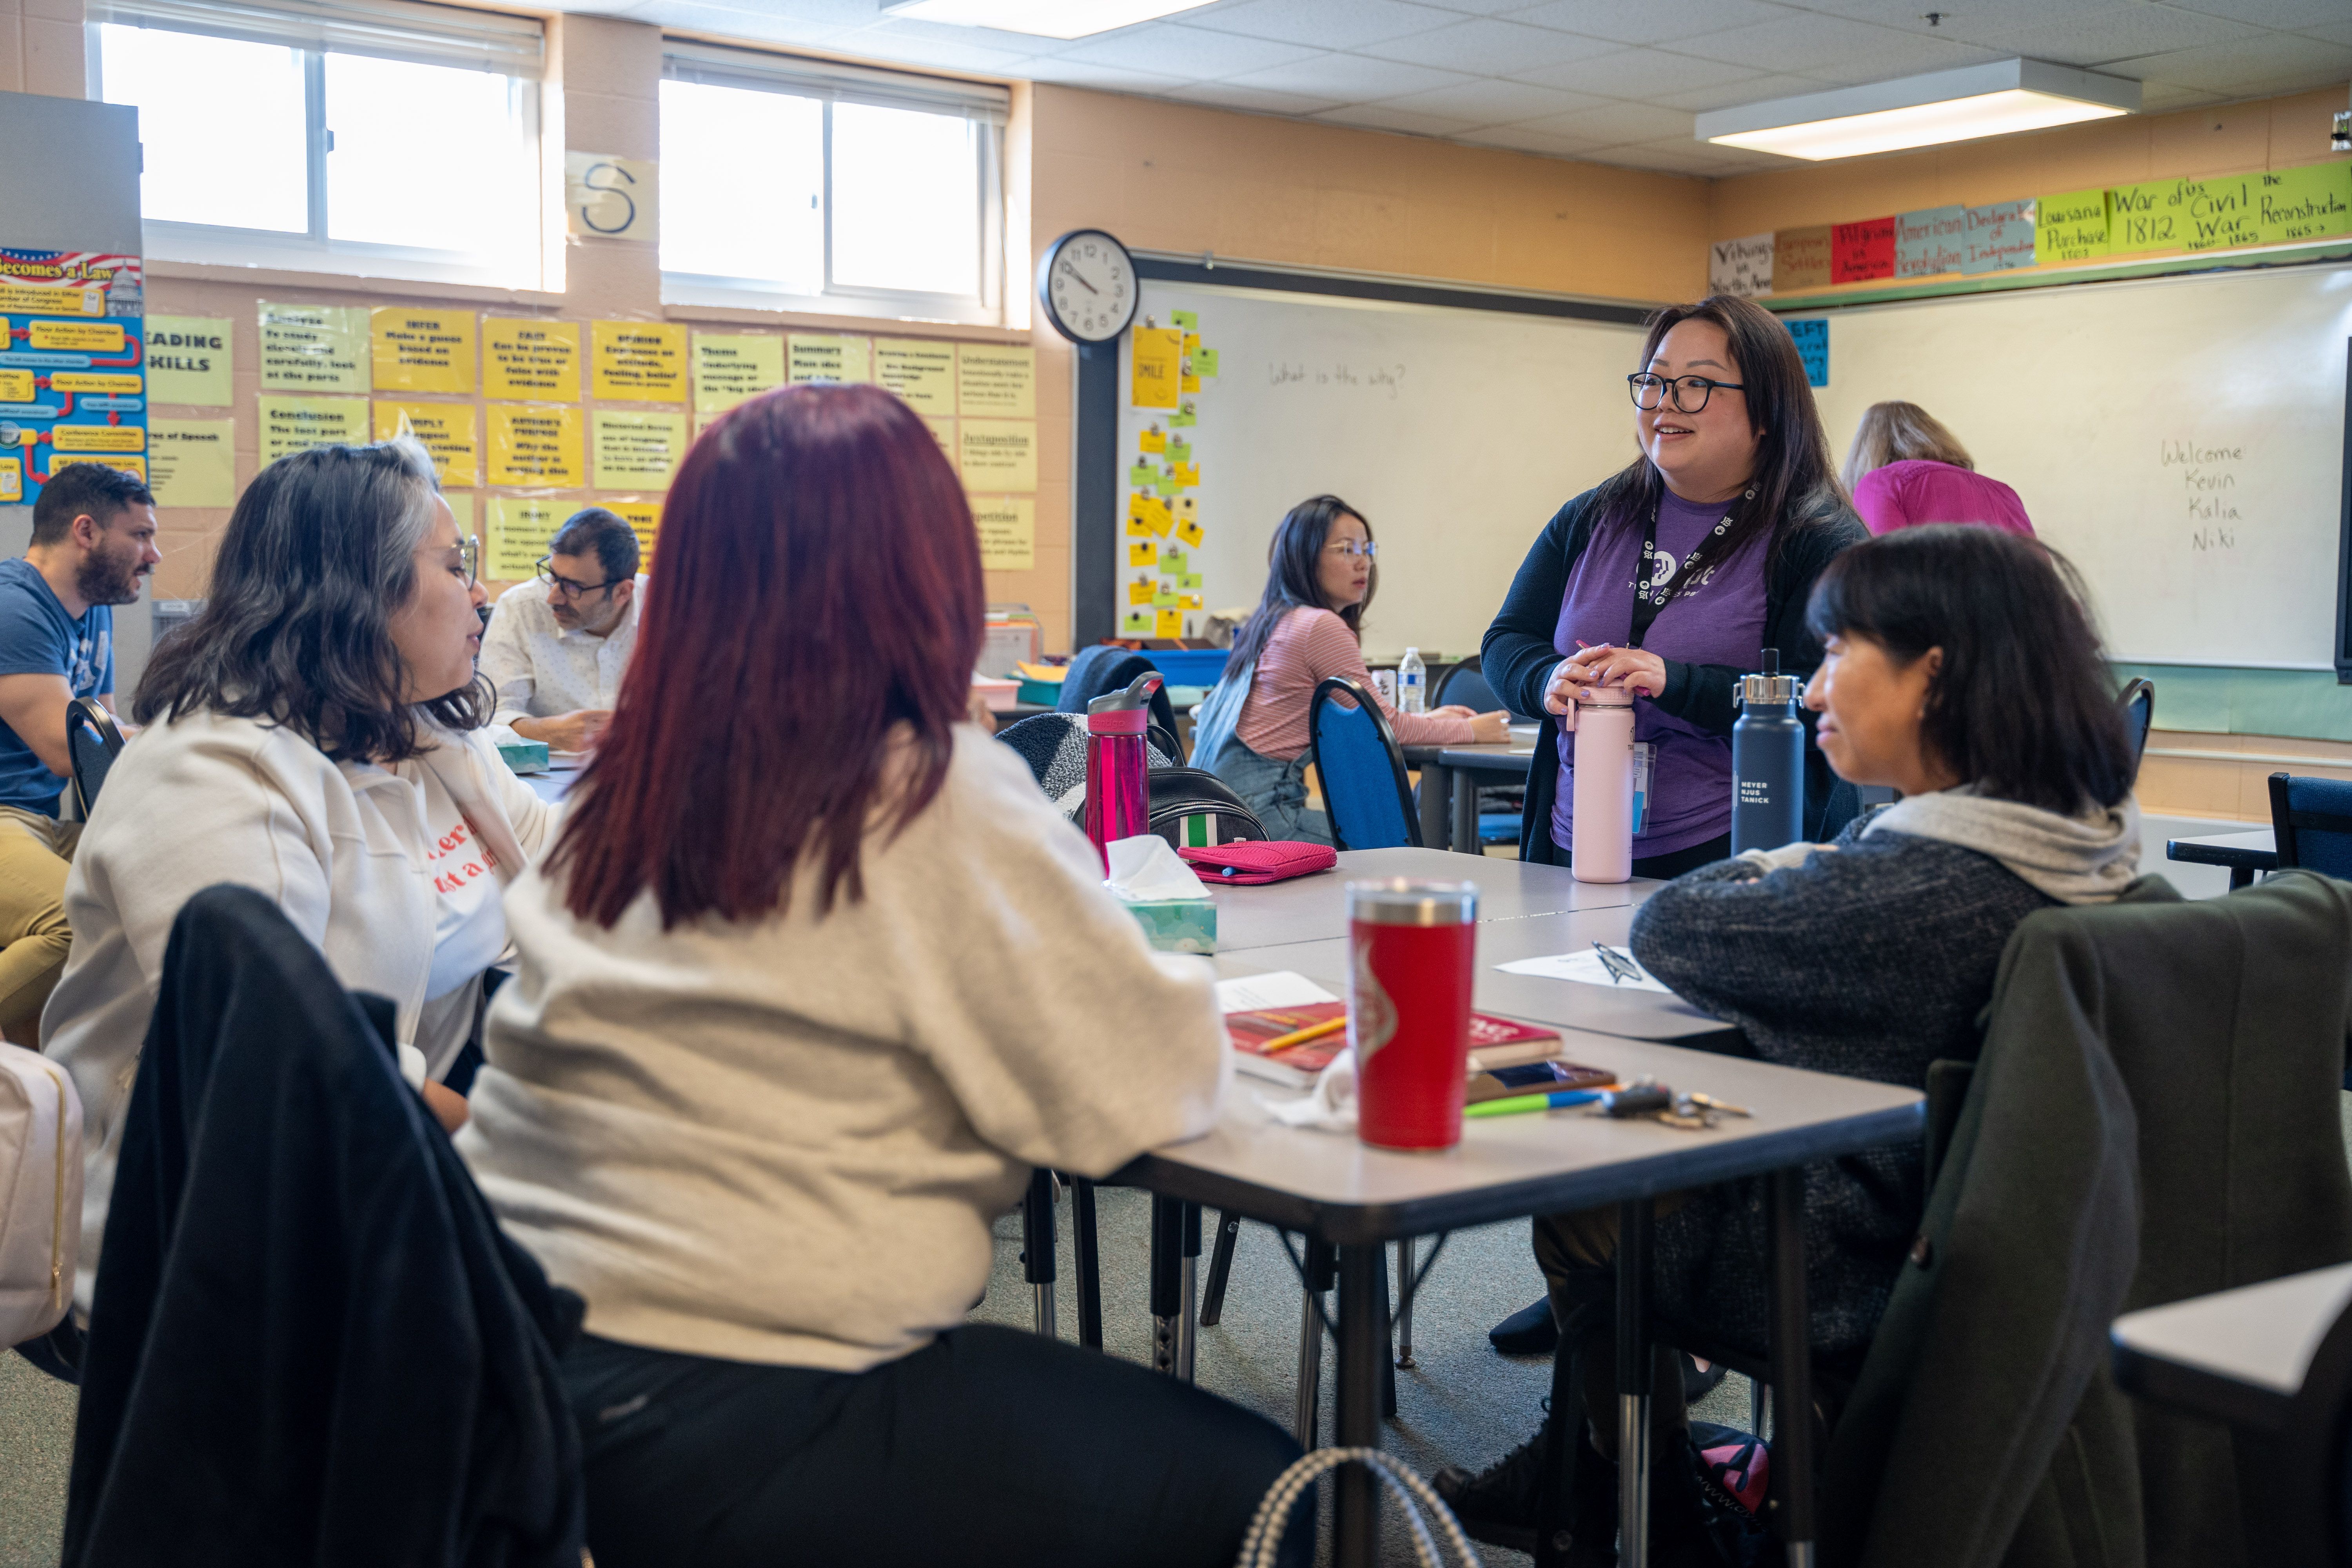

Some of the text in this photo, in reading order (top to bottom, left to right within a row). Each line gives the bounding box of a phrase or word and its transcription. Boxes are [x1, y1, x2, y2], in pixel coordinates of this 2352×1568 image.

[581, 161, 636, 234] S
[2114, 180, 2184, 213] War of
[2190, 182, 2249, 218] Civil
[2126, 215, 2176, 245] 1812
[2196, 215, 2252, 238] War
[1071, 249, 1082, 263] 11
[1084, 244, 1097, 258] 12
[0, 257, 114, 280] ecomes a Law
[1110, 266, 1121, 281] 2
[1055, 276, 1065, 292] 9
[1115, 283, 1124, 298] 3
[1058, 296, 1069, 312] 8
[1110, 302, 1119, 315] 4
[1070, 310, 1080, 325] 7
[1083, 317, 1094, 332] 6
[1099, 314, 1109, 328] 5
[1790, 321, 1825, 338] EFT
[793, 345, 842, 356] Summary
[146, 355, 211, 372] KILLS
[1137, 363, 1165, 380] SMILE
[1268, 362, 1307, 386] What
[270, 410, 344, 421] Conclusion
[963, 432, 1030, 446] Juxtaposition
[2184, 466, 2236, 491] Kevin
[2188, 495, 2243, 521] Kalia
[2192, 526, 2235, 552] Niki
[1683, 565, 1715, 589] pt
[462, 862, 485, 877] a
